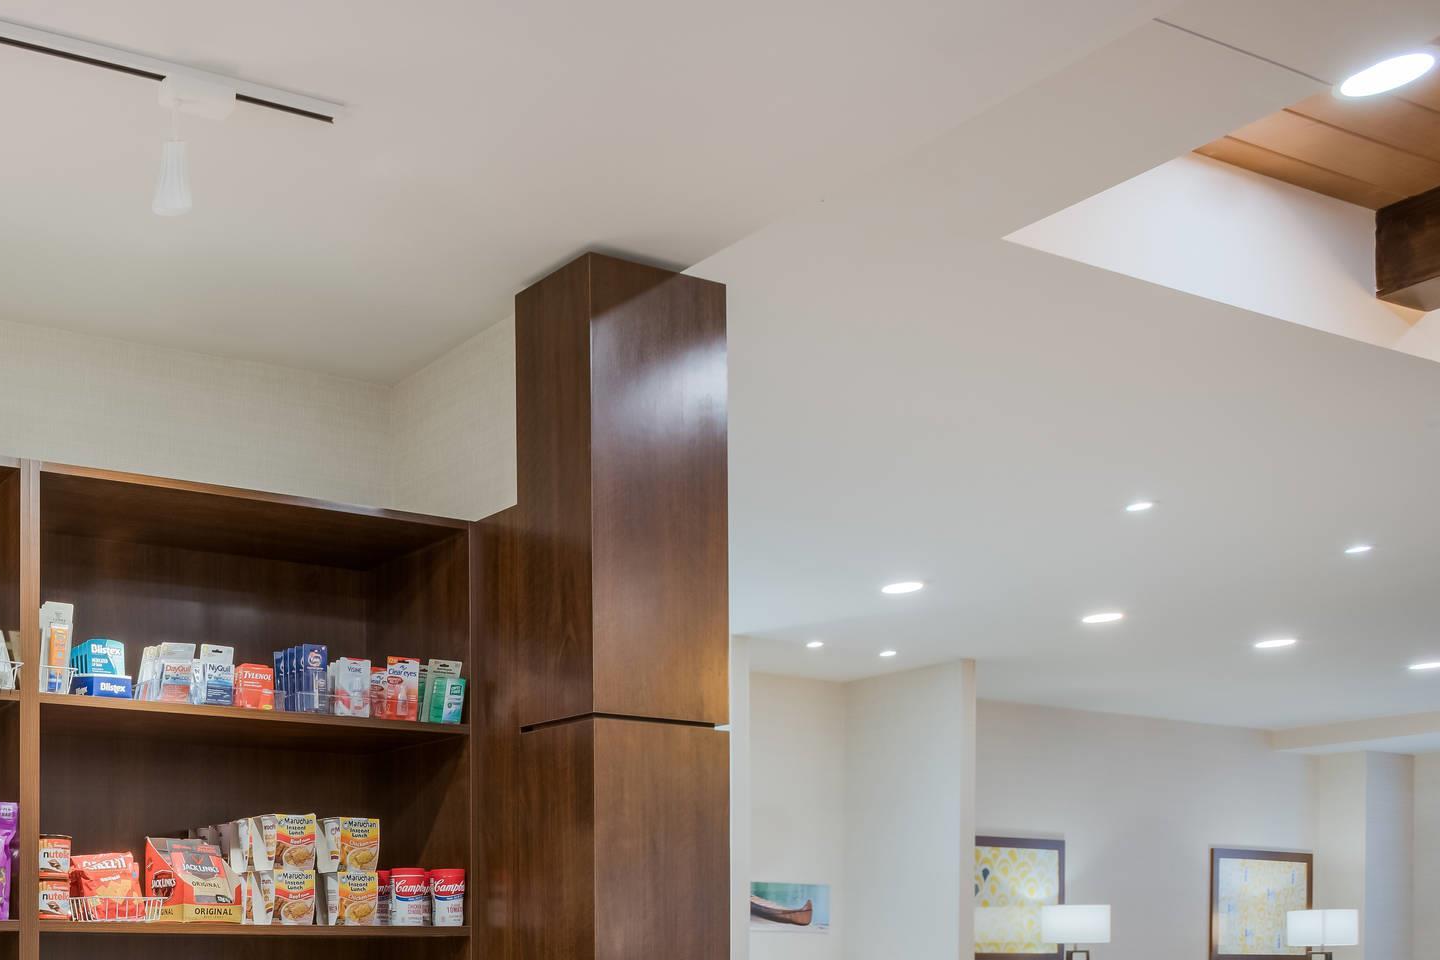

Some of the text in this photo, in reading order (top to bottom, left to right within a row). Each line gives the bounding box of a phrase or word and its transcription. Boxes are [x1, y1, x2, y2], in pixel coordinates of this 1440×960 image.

[208, 663, 231, 674] NyQuil
[284, 817, 313, 826] Maruchan
[348, 820, 377, 828] Maruchan
[282, 872, 312, 881] Maruchan
[346, 874, 375, 883] Maruchan
[191, 880, 221, 889] ORIGINAL
[194, 907, 233, 916] ORIGINAL
